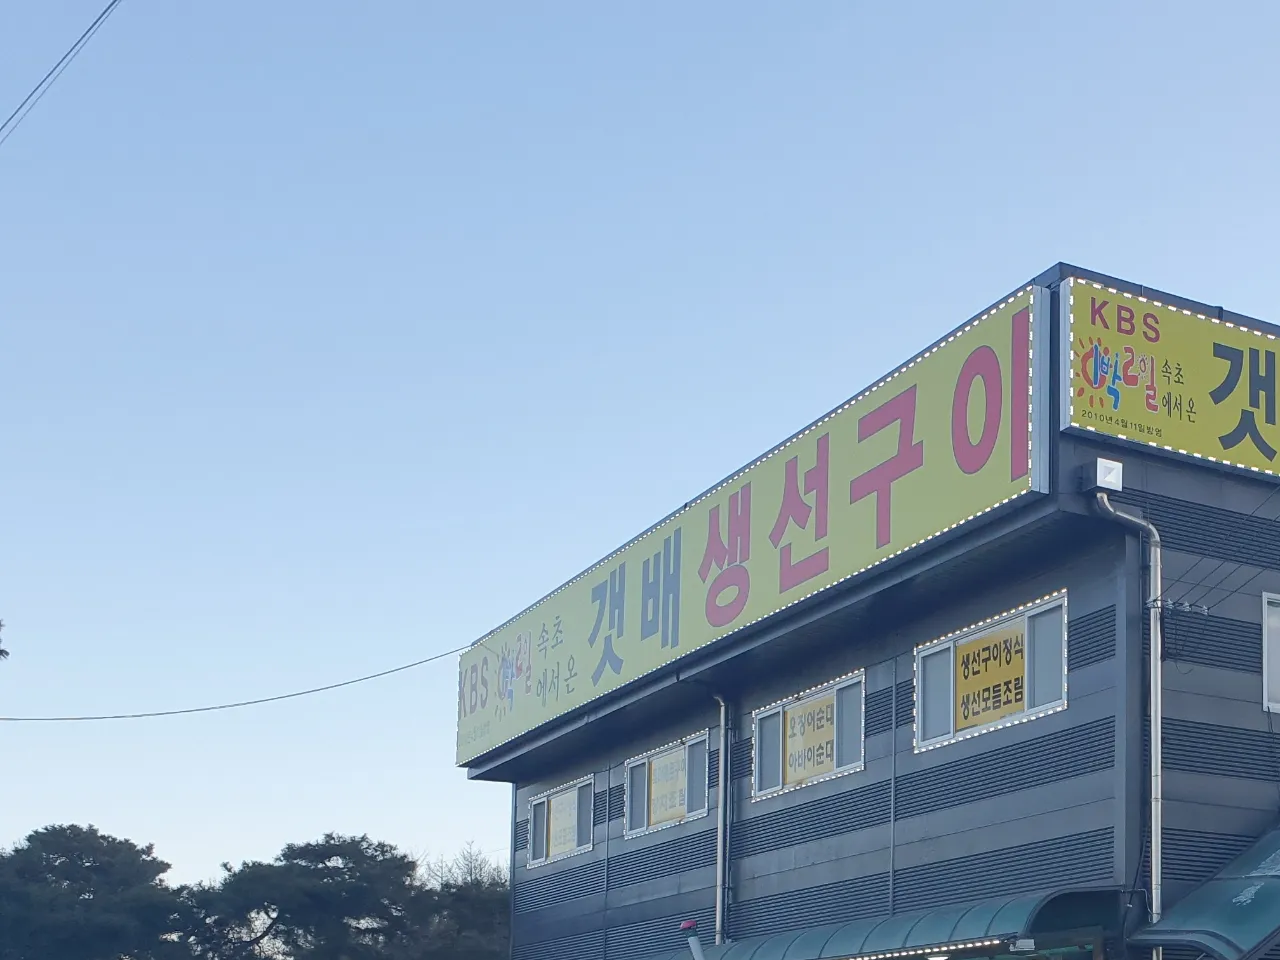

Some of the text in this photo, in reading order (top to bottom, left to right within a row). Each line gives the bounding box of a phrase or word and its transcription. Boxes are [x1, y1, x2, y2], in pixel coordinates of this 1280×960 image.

[1090, 296, 1161, 343] KBS
[1083, 343, 1159, 413] 1박2일
[1161, 358, 1185, 385] 속초
[1081, 409, 1113, 425] 2010년
[587, 305, 1029, 687] 갯배 생선구이
[536, 615, 564, 660] 속초
[961, 633, 1024, 681] 생선구이정식
[458, 655, 489, 720] KBS
[961, 675, 1024, 721] 생선모듬조림
